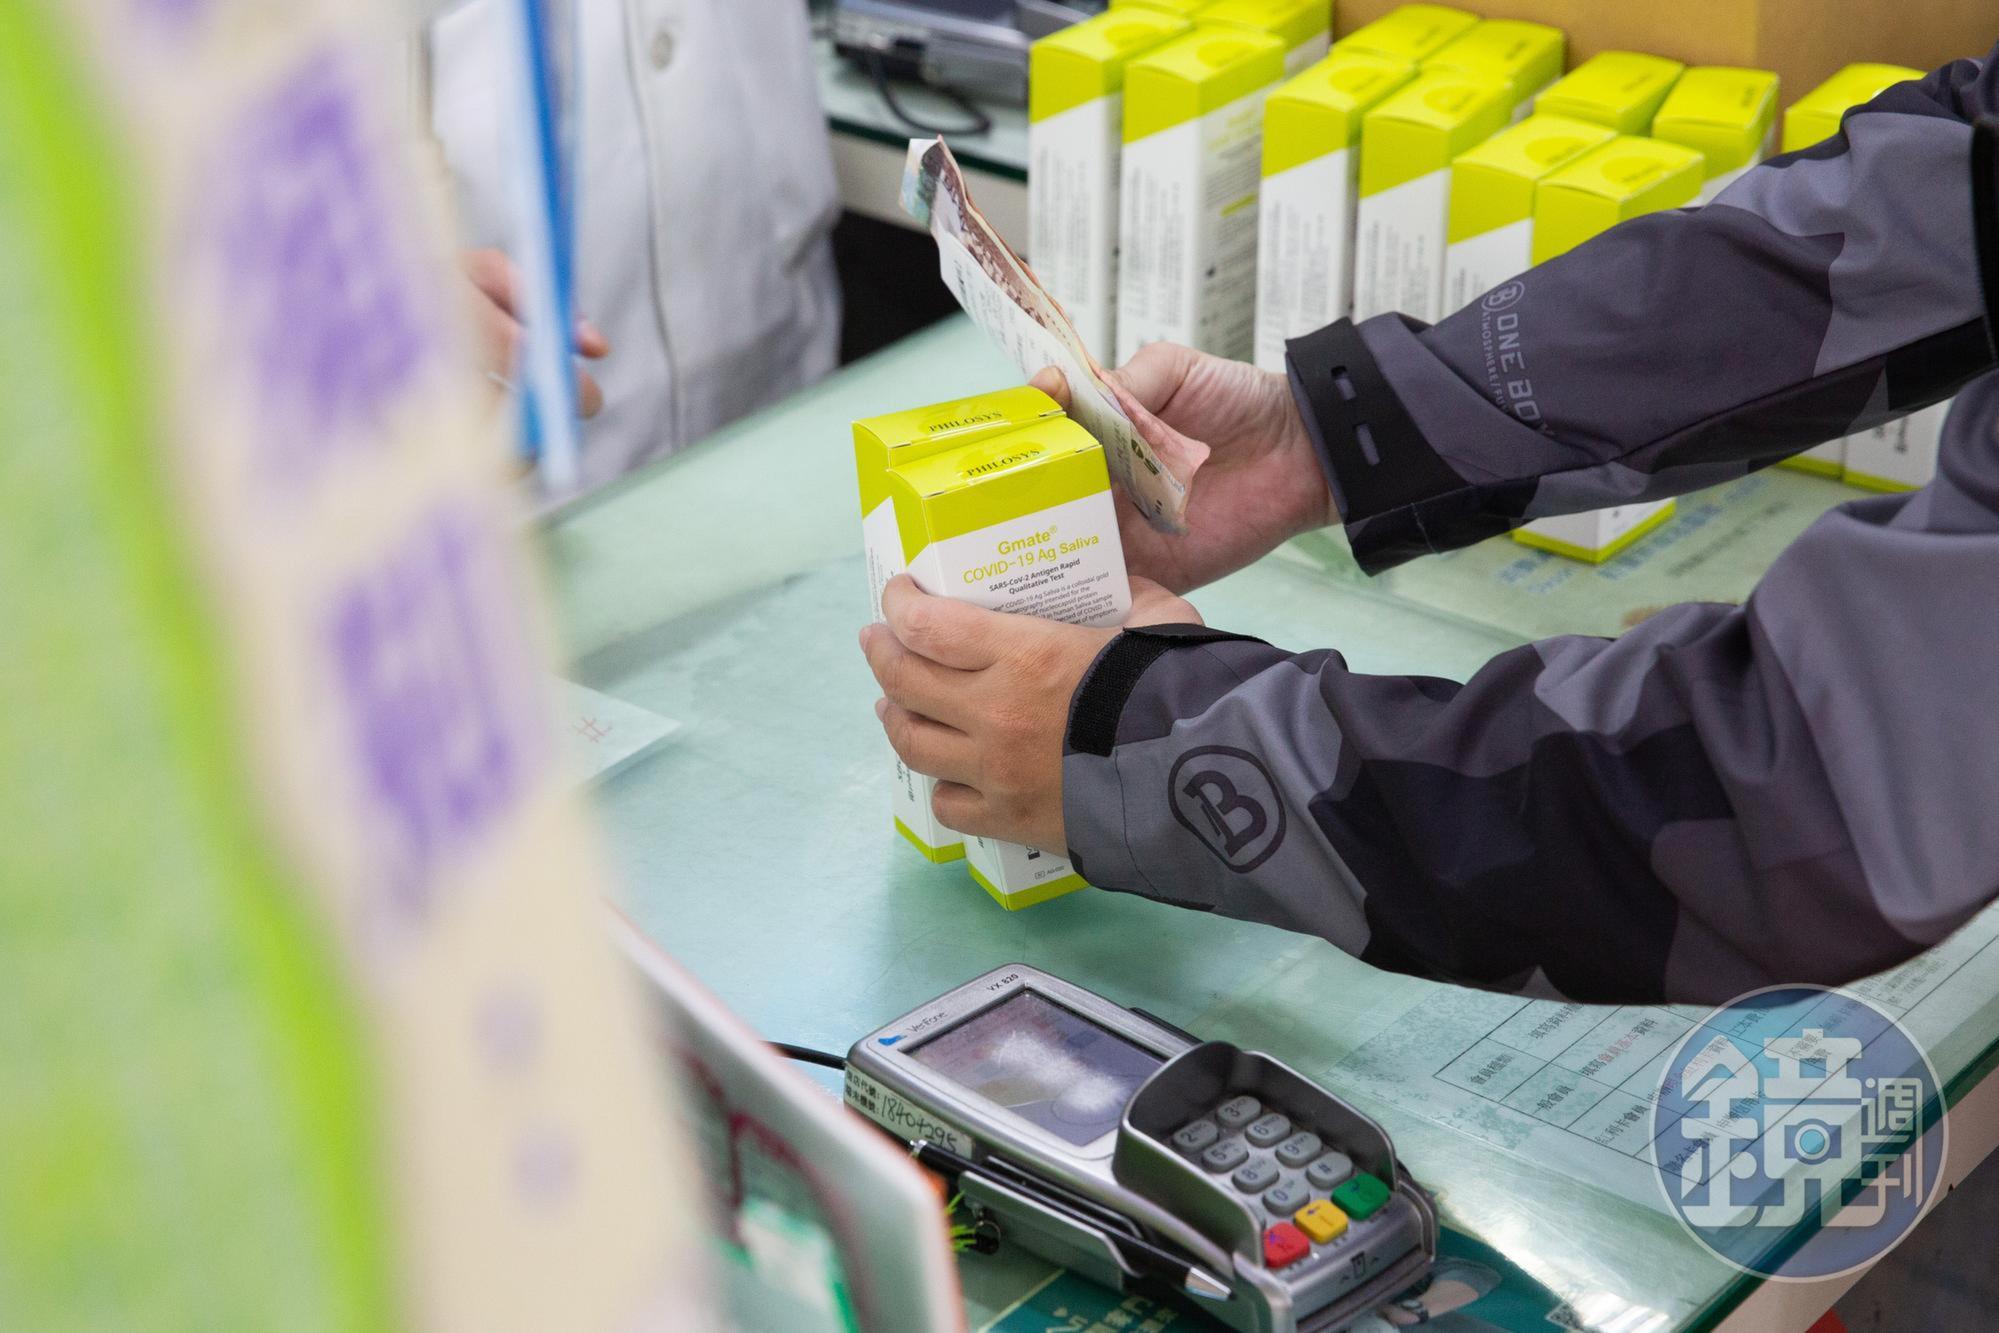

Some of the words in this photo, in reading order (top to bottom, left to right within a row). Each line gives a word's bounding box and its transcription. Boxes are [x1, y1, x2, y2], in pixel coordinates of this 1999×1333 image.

[1497, 313, 1525, 373] ONE
[929, 410, 1003, 432] PHILOSYS
[966, 448, 1040, 476] PHILOSYS
[963, 552, 1035, 584] COVID-19
[1038, 547, 1057, 562] Ag
[1060, 534, 1099, 554] Saliva
[989, 574, 1029, 592] SARS-CoV-2
[1031, 565, 1059, 580] Antigen
[1060, 558, 1081, 571] Rapid
[1009, 578, 1048, 595] Qualitative
[1050, 572, 1064, 582] Test
[1096, 571, 1110, 582] gold
[1182, 770, 1267, 858] B
[1001, 973, 1019, 984] 820
